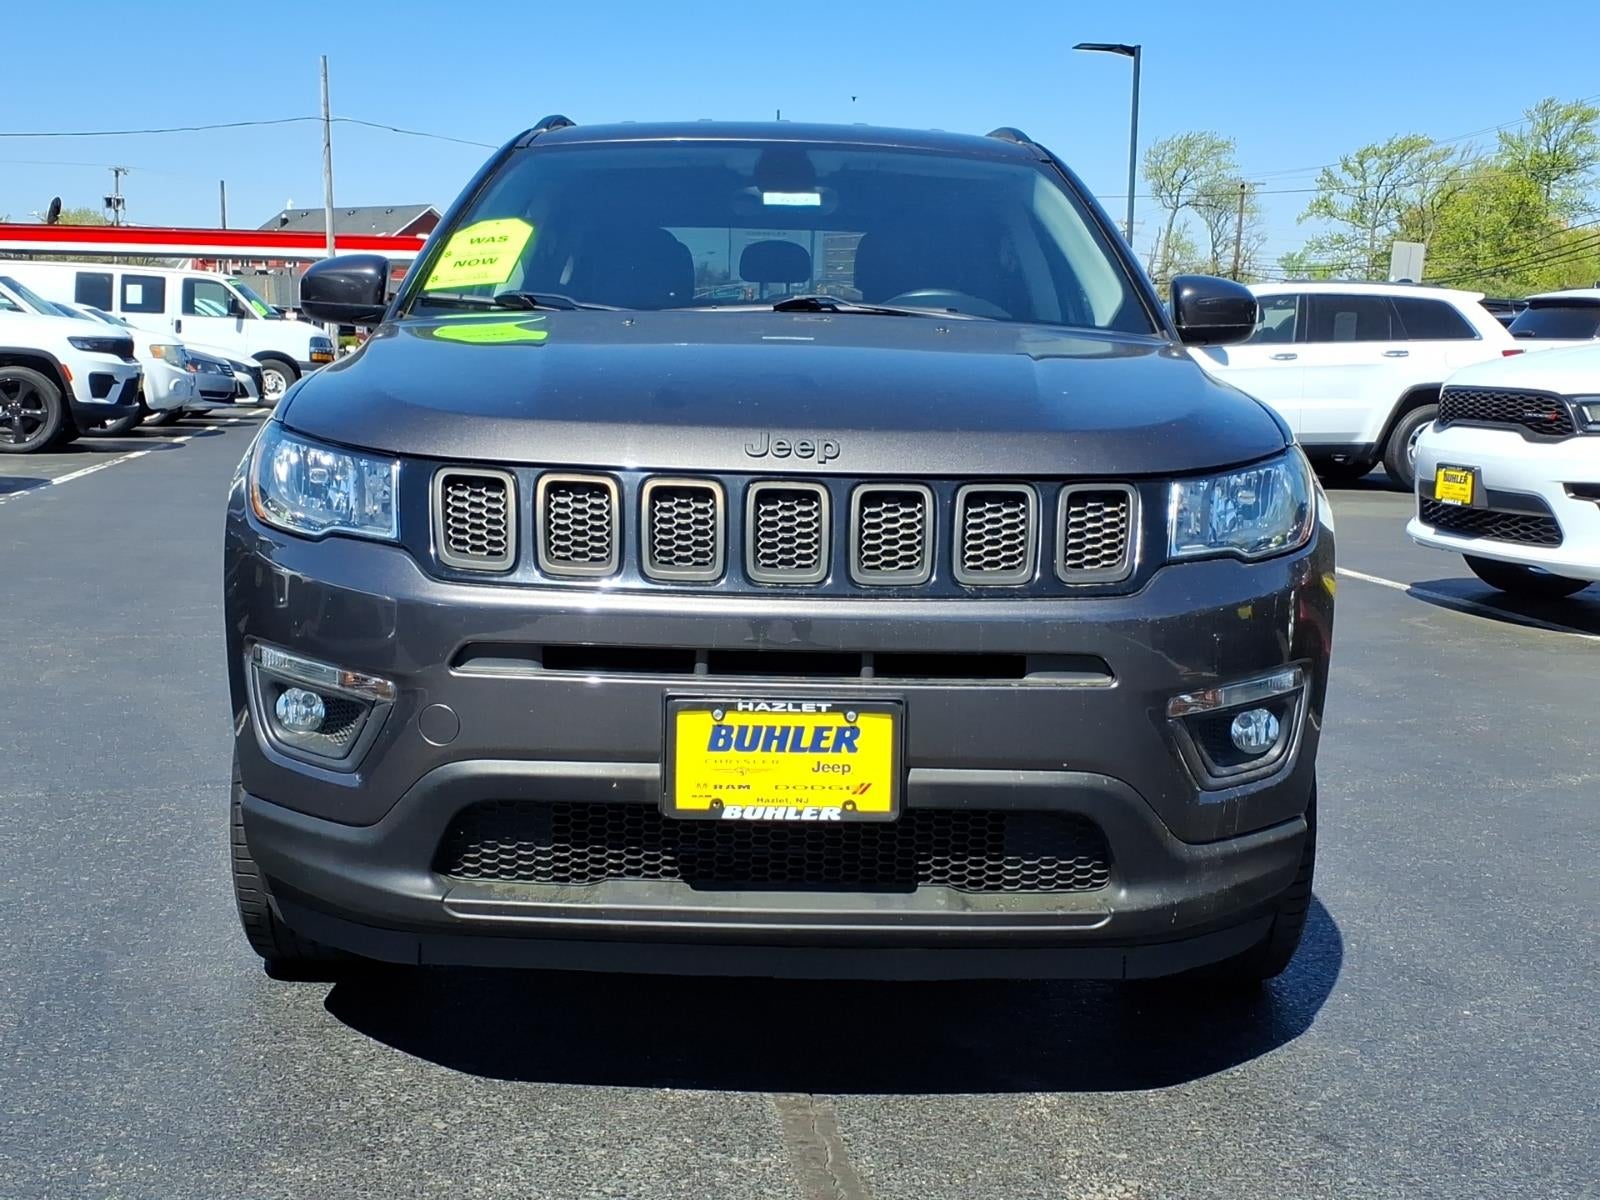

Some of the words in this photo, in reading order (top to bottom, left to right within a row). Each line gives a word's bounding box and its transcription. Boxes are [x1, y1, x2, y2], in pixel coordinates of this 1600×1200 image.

[470, 236, 508, 245] WAS
[453, 257, 498, 268] NOW
[744, 432, 840, 464] Jeep
[737, 702, 832, 713] HAZLET
[707, 724, 861, 753] BUHLER
[811, 760, 852, 775] Jeep
[721, 806, 842, 821] BUHLER
